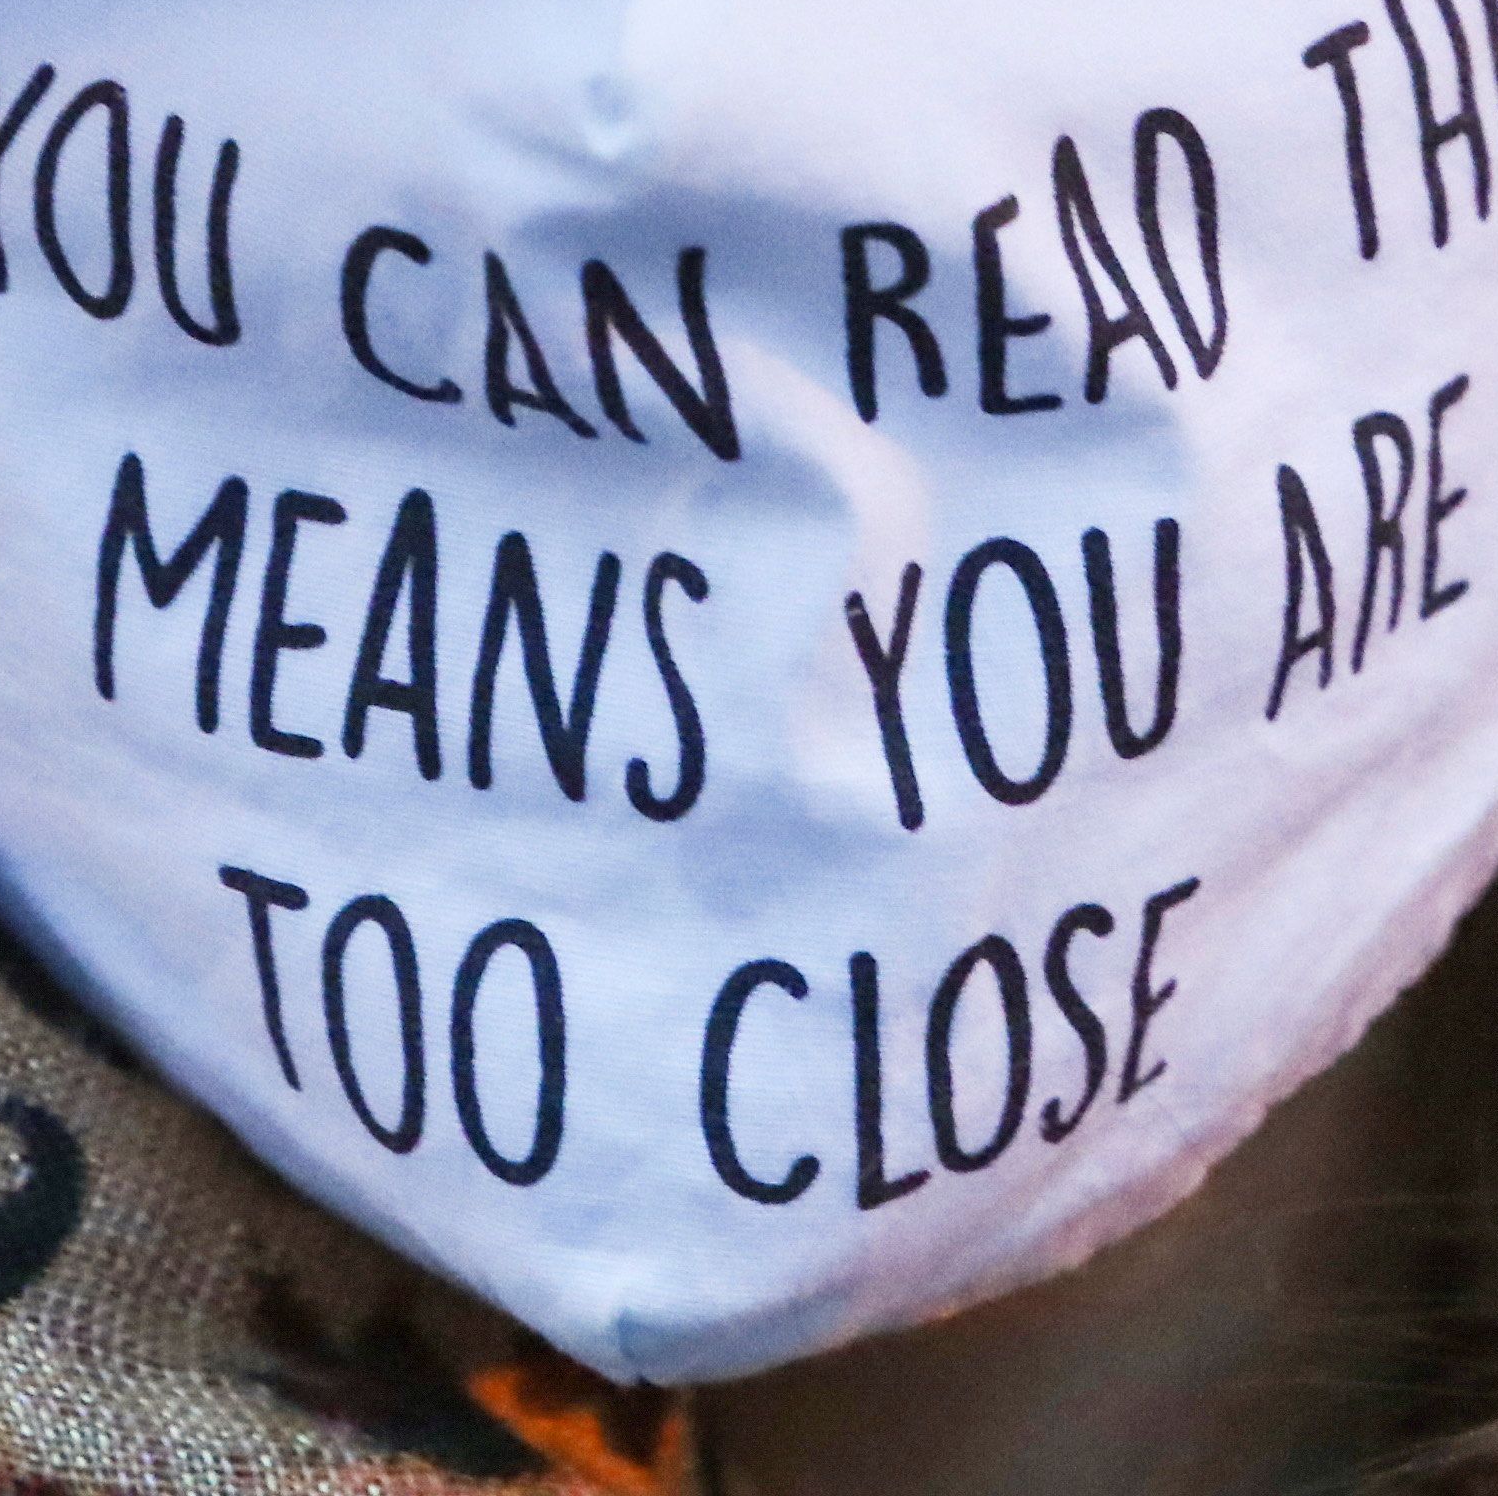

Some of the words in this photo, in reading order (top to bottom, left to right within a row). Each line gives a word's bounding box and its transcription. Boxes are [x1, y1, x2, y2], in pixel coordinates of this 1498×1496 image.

[338, 223, 745, 466] CAN
[837, 106, 1231, 425] READ
[92, 451, 710, 825] MEANS
[843, 516, 1184, 834] YOU
[1264, 373, 1472, 722] ARE
[217, 863, 568, 1189] TOO
[698, 875, 1203, 1213] CLOSE
